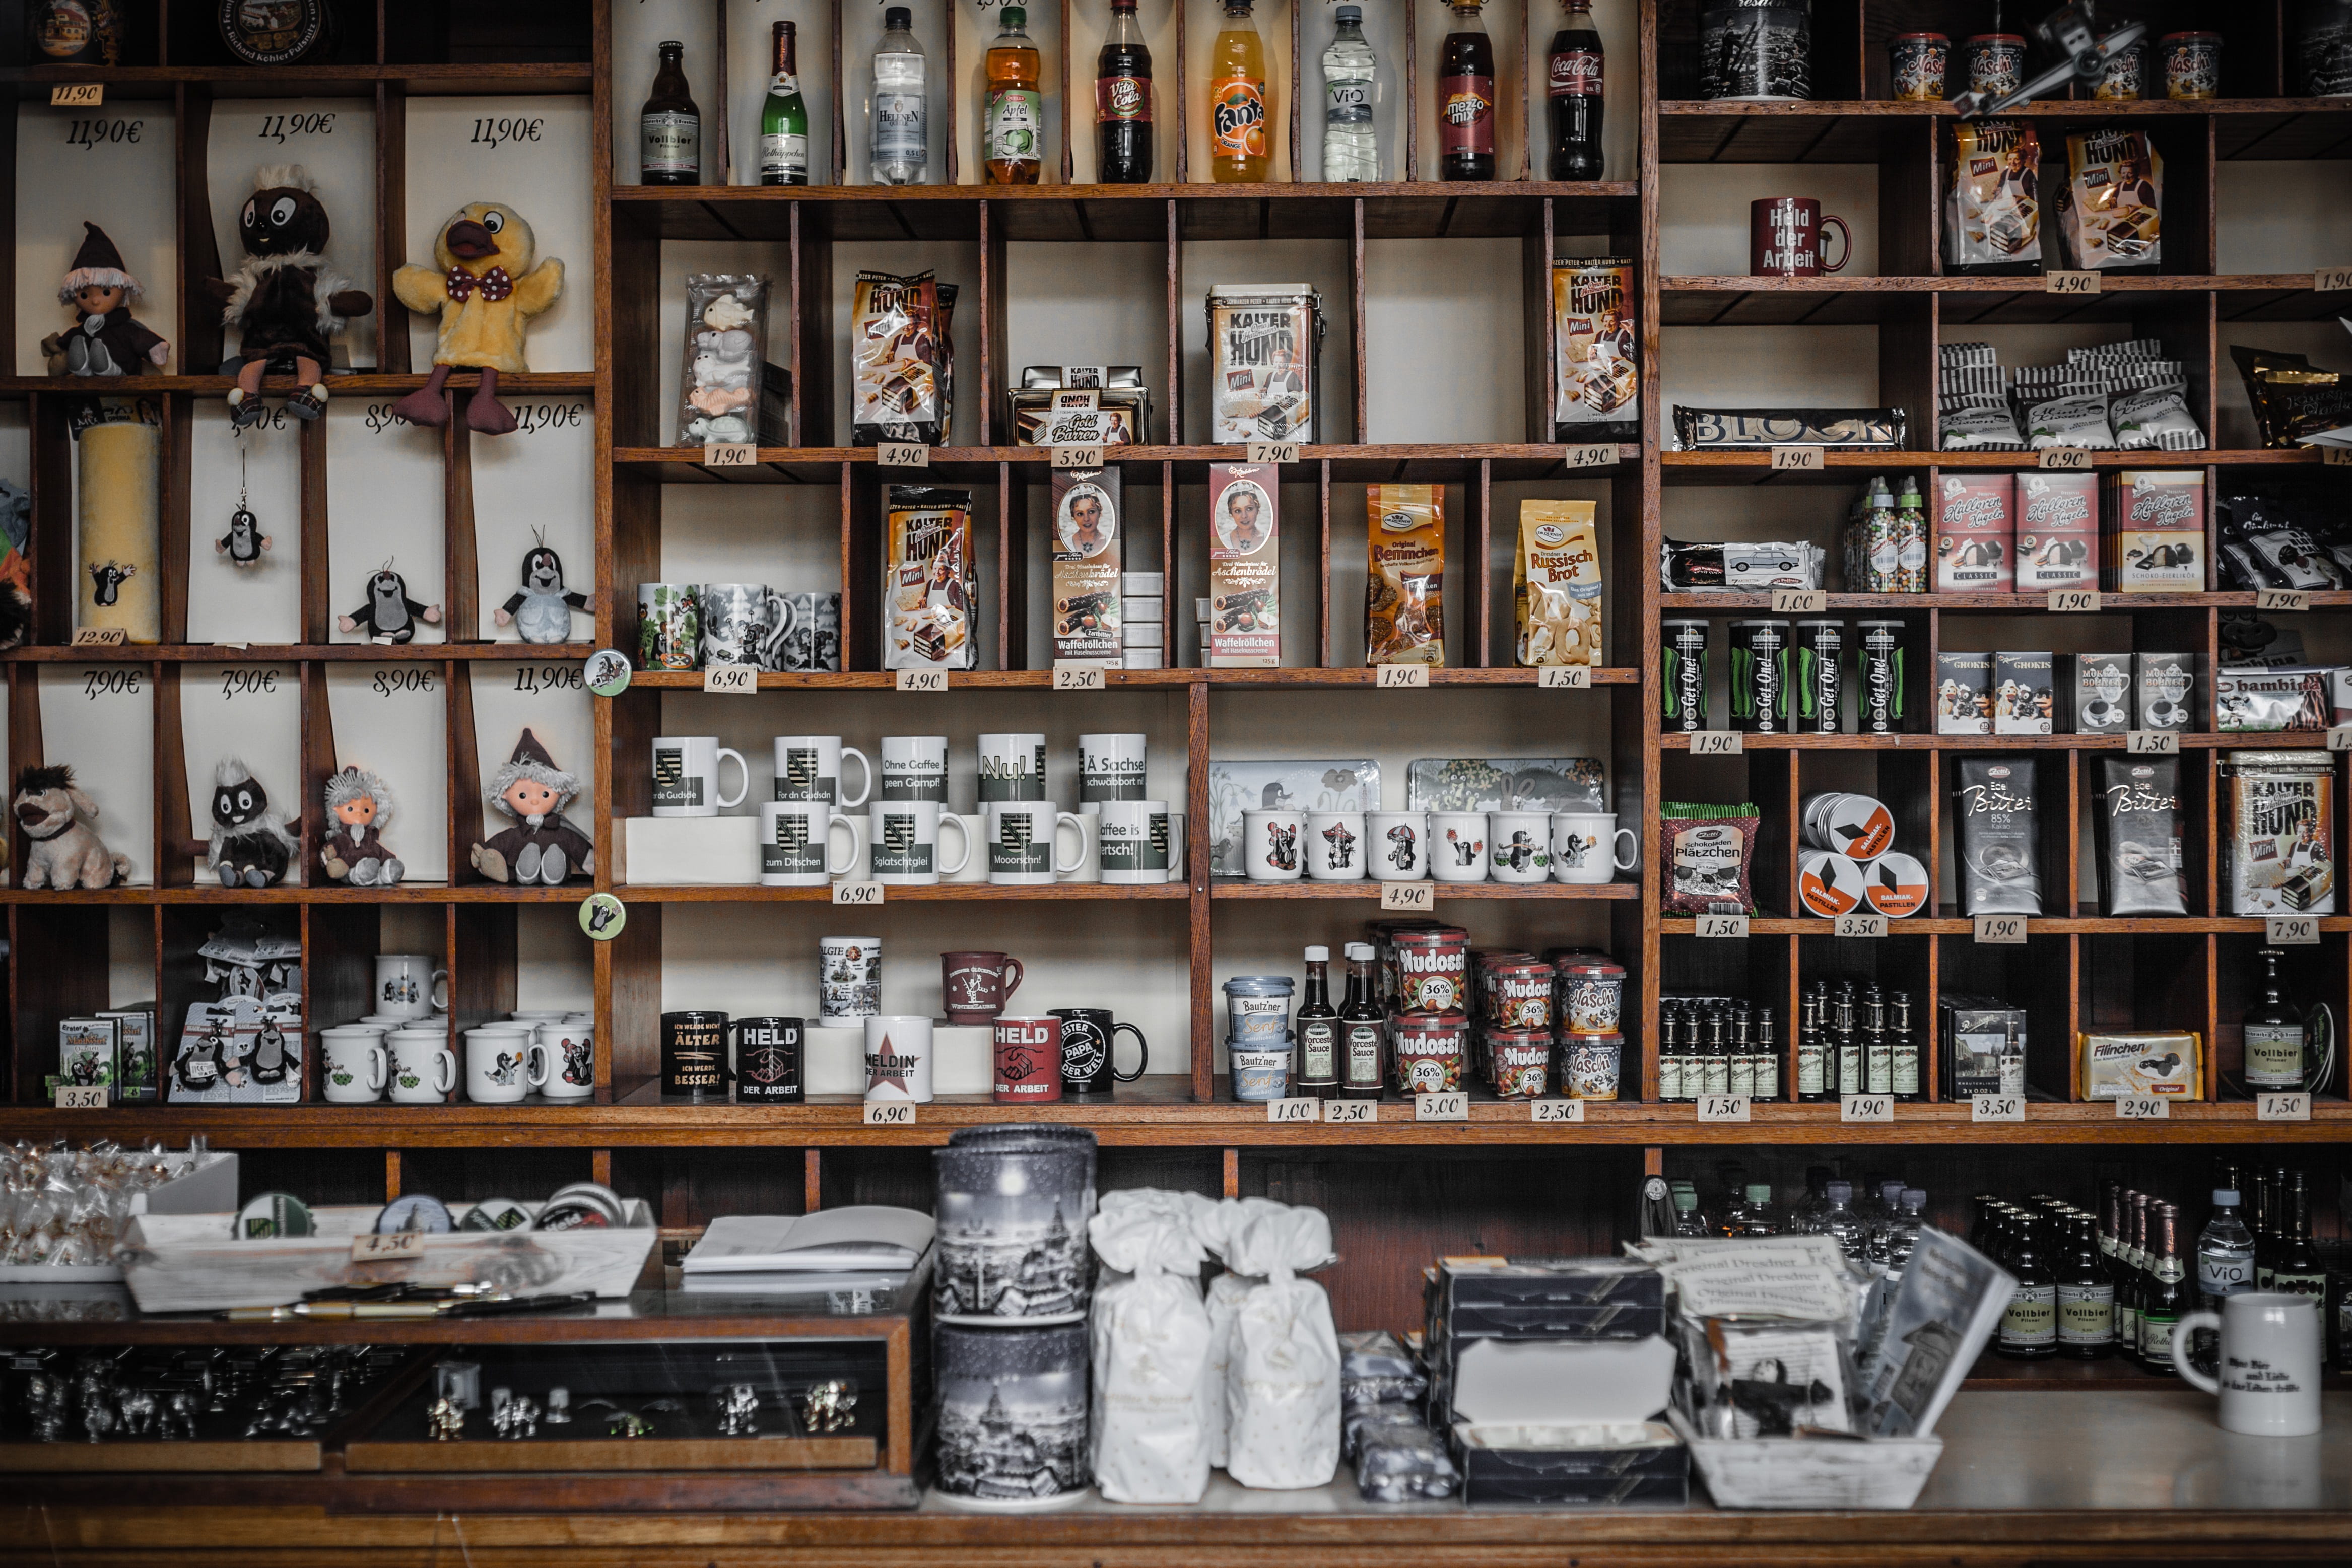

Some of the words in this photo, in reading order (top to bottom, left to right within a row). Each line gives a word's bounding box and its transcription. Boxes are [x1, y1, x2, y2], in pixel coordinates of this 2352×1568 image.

[228, 31, 254, 58] Richard
[257, 53, 288, 62] Köhler
[289, 24, 315, 56] Pulsnitz
[1970, 54, 2013, 76] Naschi
[2166, 52, 2211, 75] Naschi
[56, 86, 97, 101] 11,90
[1110, 83, 1137, 96] Vita
[1113, 92, 1141, 108] Cola
[1448, 99, 1484, 115] mezzo
[879, 111, 919, 123] HELENEN
[1003, 104, 1028, 117] Apfel
[1452, 110, 1475, 124] mix
[66, 120, 143, 150] 11,90€
[259, 113, 336, 144] 11,90€
[471, 118, 544, 148] 11,90€
[649, 136, 691, 144] Vollbier
[1221, 139, 1242, 150] ORANGE
[761, 145, 805, 159] Rotkäppchen
[1973, 159, 1994, 174] Mini
[1770, 209, 1809, 227] Held
[1775, 232, 1805, 247] der
[1764, 250, 1813, 268] Arbeit
[2054, 276, 2091, 293] 4,90
[1571, 287, 1623, 314] HUND
[1230, 313, 1291, 328] KALTER
[1570, 320, 1590, 331] Mini
[1230, 330, 1293, 366] HUND
[1230, 372, 1251, 390] Mini
[1068, 414, 1098, 431] Gold
[1697, 414, 1894, 443] BLOCK
[1052, 426, 1100, 442] Barren
[713, 448, 747, 465] 1,90
[886, 448, 922, 463] 4,90
[1060, 450, 1095, 466] 5,90
[1257, 446, 1292, 463] 7,90
[1574, 448, 1609, 467] 4,90
[2047, 452, 2084, 468] 0,90
[1943, 496, 2002, 523] Halloren
[2131, 495, 2192, 521] Halloren
[1969, 510, 2005, 528] Kugeln
[2156, 508, 2194, 526] Kugeln
[1374, 544, 1439, 562] Bemmchen
[1531, 549, 1593, 569] Russisch
[902, 569, 922, 582] Mini
[1054, 568, 1119, 579] Aschenbrödel
[1212, 566, 1276, 577] Aschenbrödel
[1548, 565, 1579, 583] Brot
[1780, 594, 1814, 612] 1,00
[2057, 593, 2091, 611] 1,90
[2267, 594, 2302, 609] 1,90
[77, 630, 122, 646] 12,90
[1088, 630, 1112, 638] Zartbitter
[1214, 637, 1274, 648] Waffelröllchen
[1058, 640, 1118, 649] Waffelröllchen
[712, 670, 748, 687] 6,90
[1681, 657, 1697, 684] One!
[83, 671, 143, 700] 7,90€
[220, 670, 280, 699] 7,90€
[373, 669, 434, 698] 8,90€
[513, 667, 584, 696] 11,90€
[905, 673, 940, 691] 4,90
[1061, 671, 1096, 689] 2,50
[1548, 671, 1581, 688] 1,50
[2236, 679, 2321, 692] bambina
[1681, 688, 1696, 706] Get
[1699, 735, 1732, 753] 1,90
[2136, 736, 2170, 754] 1,50
[885, 760, 906, 770] Ohne
[908, 758, 940, 770] Gaffee
[982, 756, 1027, 780] Nu!
[1087, 755, 1097, 771] Ä
[1102, 757, 1144, 771] Sachse
[885, 780, 903, 789] geen
[906, 776, 940, 788] Gampf!
[1963, 785, 2034, 817] Bitter
[2107, 785, 2176, 817] Bitter
[1991, 814, 2011, 823] 85%
[1860, 822, 1883, 851] SALMIAK-
[994, 855, 1041, 864] Mooorschn!
[1675, 847, 1740, 859] Plätzchen
[766, 858, 782, 866] zum
[785, 858, 821, 866] Ditschen
[840, 888, 875, 904] 6,90
[1389, 888, 1425, 905] 4,90
[1706, 920, 1739, 937] 1,50
[1842, 919, 1878, 936] 3,50
[1985, 920, 2017, 937] 1,90
[2275, 921, 2310, 939] 7,90
[1400, 948, 1465, 973] Nudossi
[1425, 984, 1449, 994] 36%
[1525, 1006, 1543, 1014] 36%
[1243, 1016, 1279, 1034] Senf
[675, 1029, 720, 1046] ÄLTER
[744, 1028, 797, 1045] HELD
[995, 1027, 1048, 1044] HELD
[1395, 1031, 1460, 1055] Nudossi
[1064, 1043, 1093, 1059] PAPA
[1308, 1044, 1330, 1052] Sauce
[1352, 1048, 1374, 1056] Sauce
[2094, 1042, 2145, 1057] Filinchen
[2254, 1049, 2297, 1057] Vollbier
[865, 1055, 915, 1068] HELDIN
[1062, 1065, 1081, 1076] DER
[1084, 1052, 1103, 1075] WELT
[675, 1074, 720, 1085] BESSER!
[865, 1068, 878, 1077] DER
[880, 1070, 914, 1078] ARBEIT
[1240, 1070, 1275, 1088] Senf
[1416, 1067, 1440, 1077] 36%
[1526, 1074, 1542, 1082] 36%
[765, 1085, 797, 1094] ARBEIT
[995, 1084, 1010, 1093] DER
[1014, 1084, 1049, 1093] ARBEIT
[65, 1090, 101, 1108] 3,50
[1424, 1098, 1459, 1116] 5,00
[1708, 1099, 1741, 1116] 1,50
[1979, 1099, 2016, 1116] 3,50
[2267, 1098, 2301, 1115] 1,50
[872, 1107, 908, 1124] 6,90
[1278, 1103, 1310, 1121] 1,00
[1333, 1105, 1368, 1122] 2,50
[1539, 1105, 1575, 1121] 2,50
[1850, 1099, 1884, 1117] 1,90
[2124, 1100, 2161, 1118] 2,90
[2209, 1264, 2243, 1281] ViO
[2008, 1309, 2051, 1318] Vollbier
[2066, 1309, 2108, 1317] Vollbier
